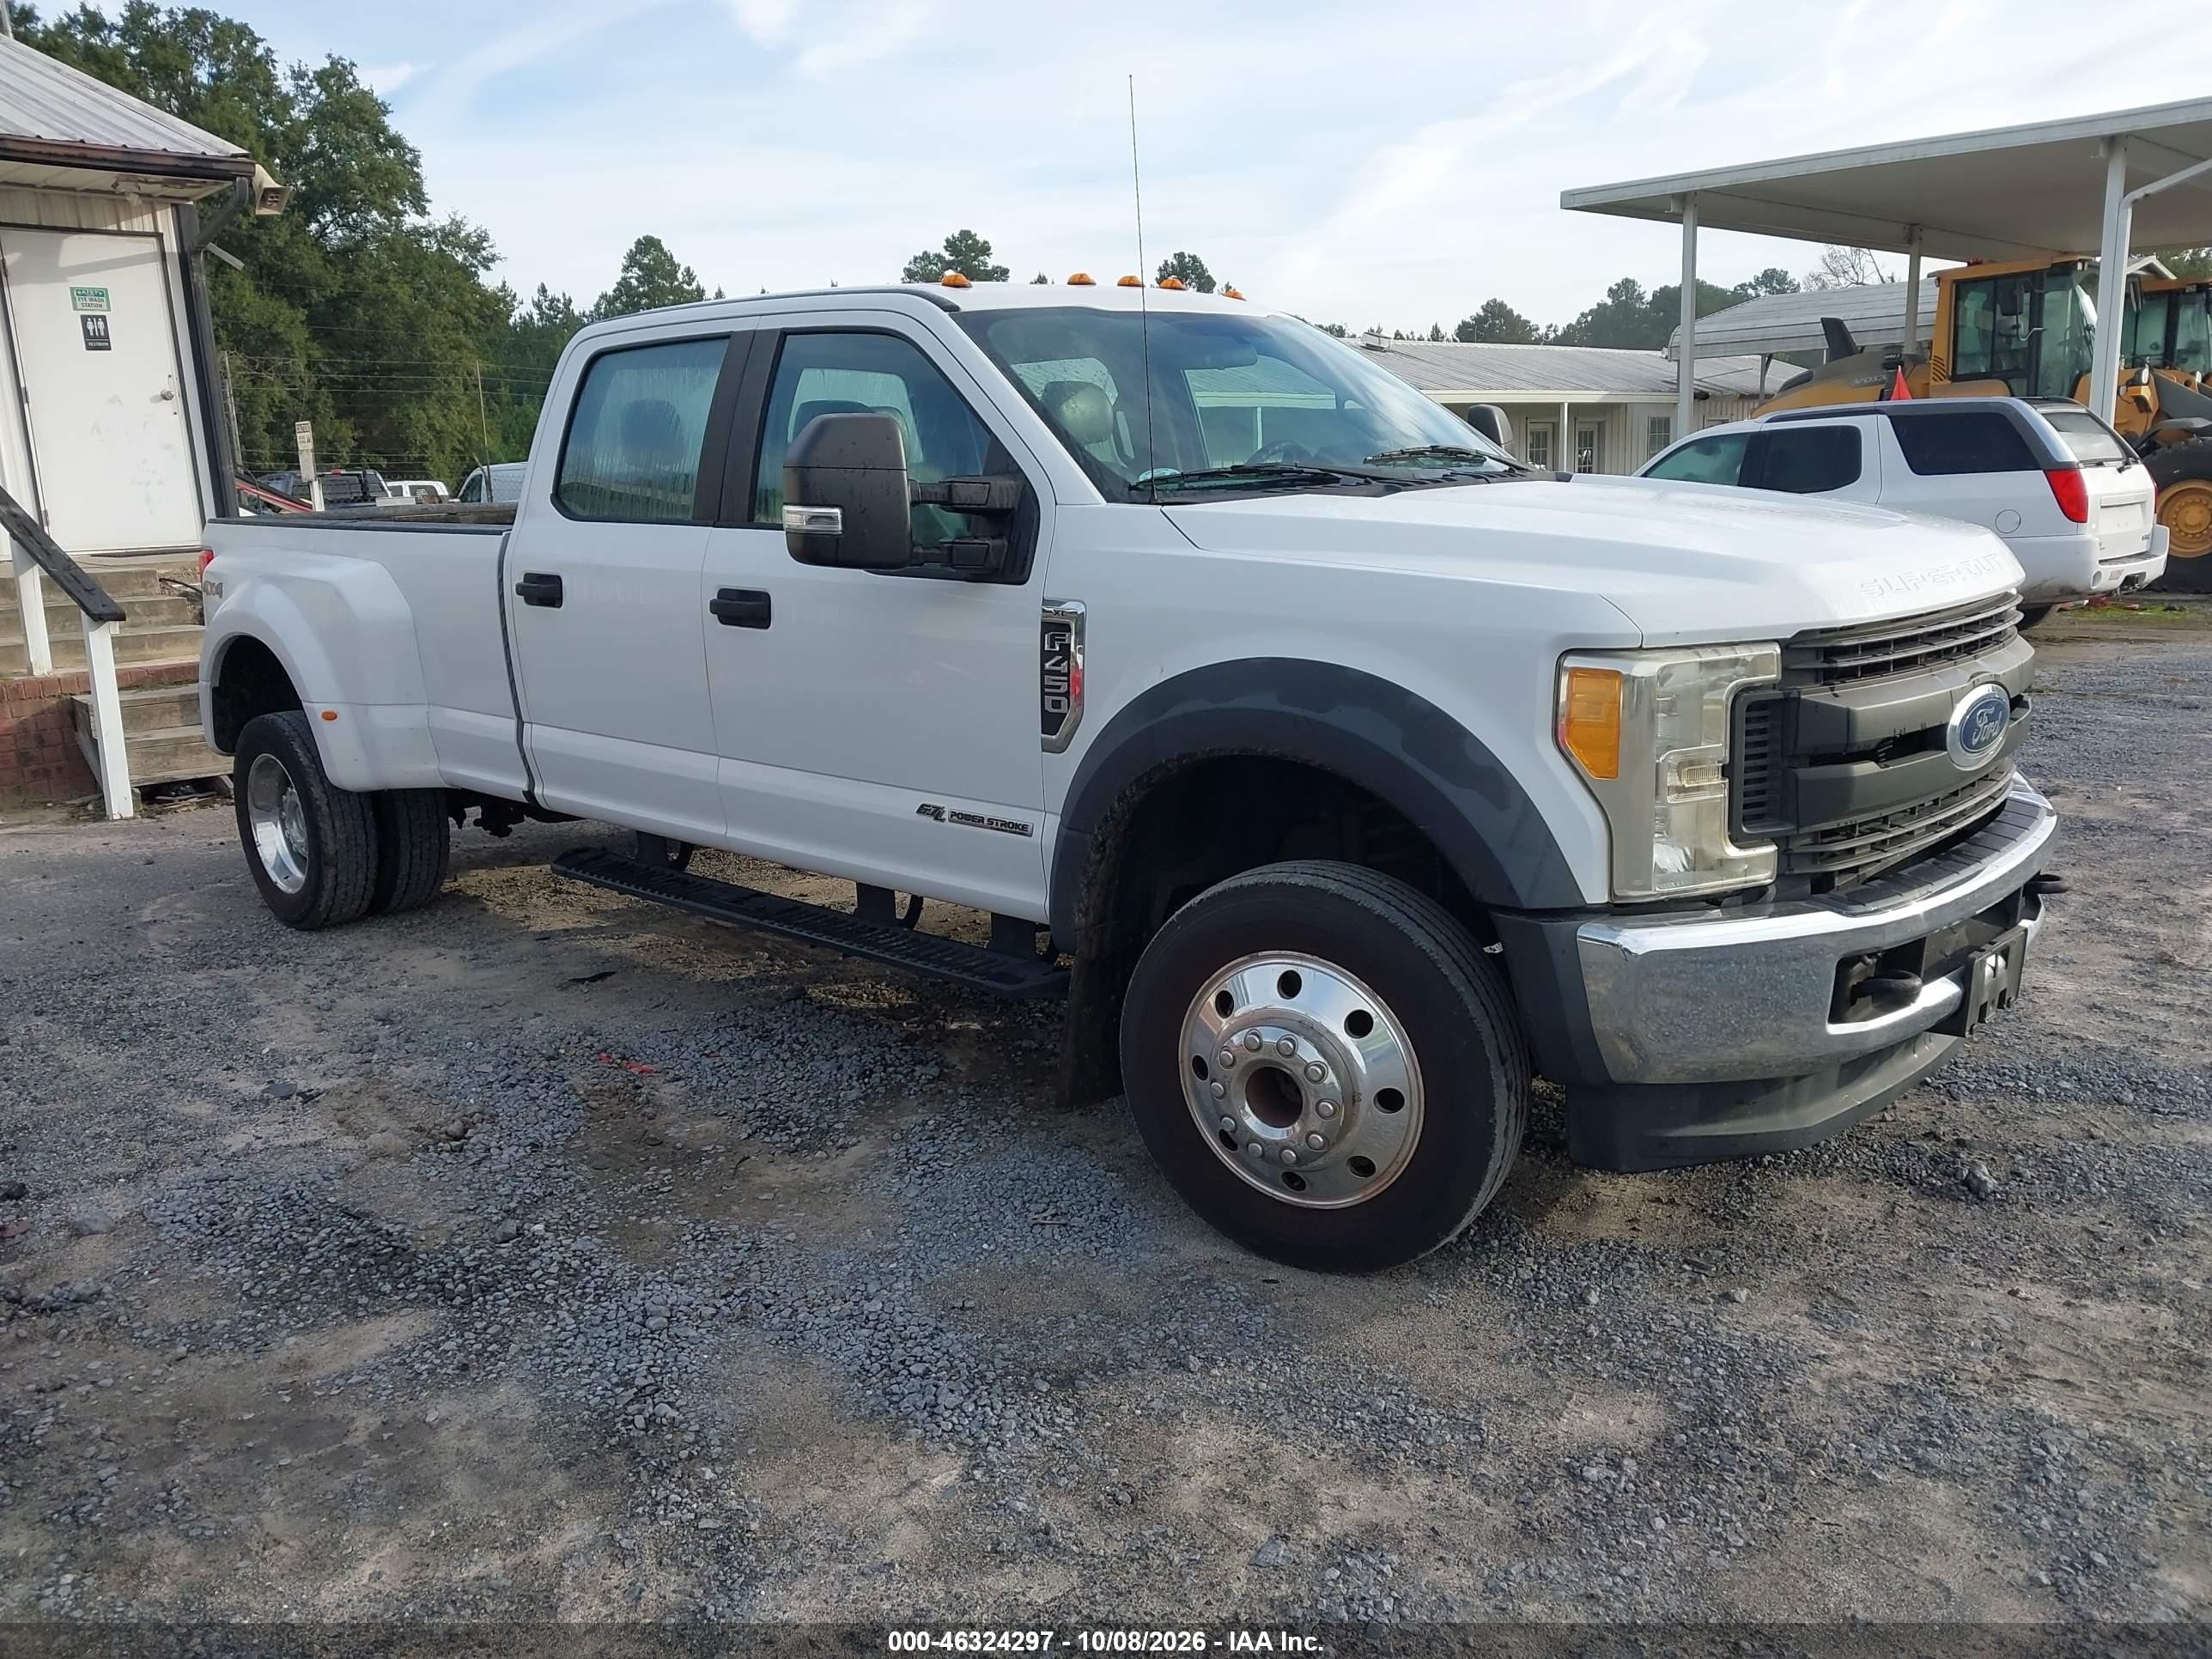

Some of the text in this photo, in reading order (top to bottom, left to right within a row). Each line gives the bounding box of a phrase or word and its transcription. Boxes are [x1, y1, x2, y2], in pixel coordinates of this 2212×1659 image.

[1860, 563, 1966, 597] SUPER
[1972, 705, 2003, 746] Ford
[949, 810, 986, 825] POWER
[986, 817, 1030, 832] STROKE
